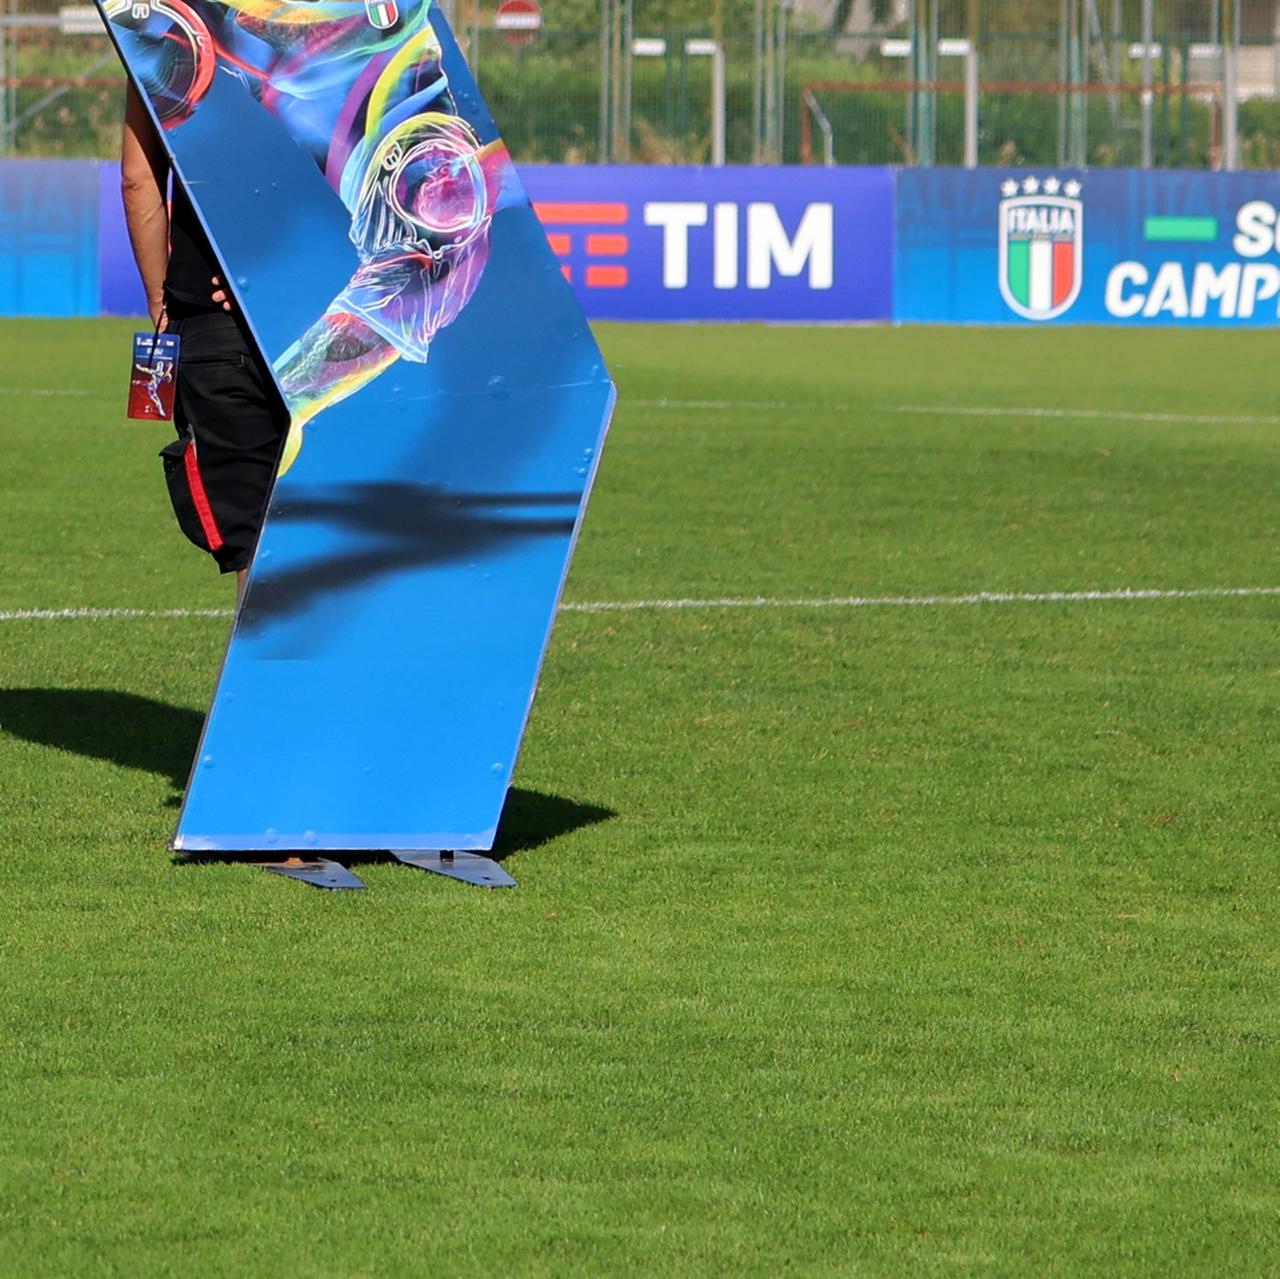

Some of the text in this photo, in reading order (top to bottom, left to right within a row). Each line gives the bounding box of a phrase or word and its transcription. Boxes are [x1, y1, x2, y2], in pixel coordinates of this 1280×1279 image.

[644, 202, 834, 290] TIM
[1008, 207, 1074, 232] ITALIA
[1233, 201, 1280, 258] S
[1105, 261, 1280, 318] CAMP
